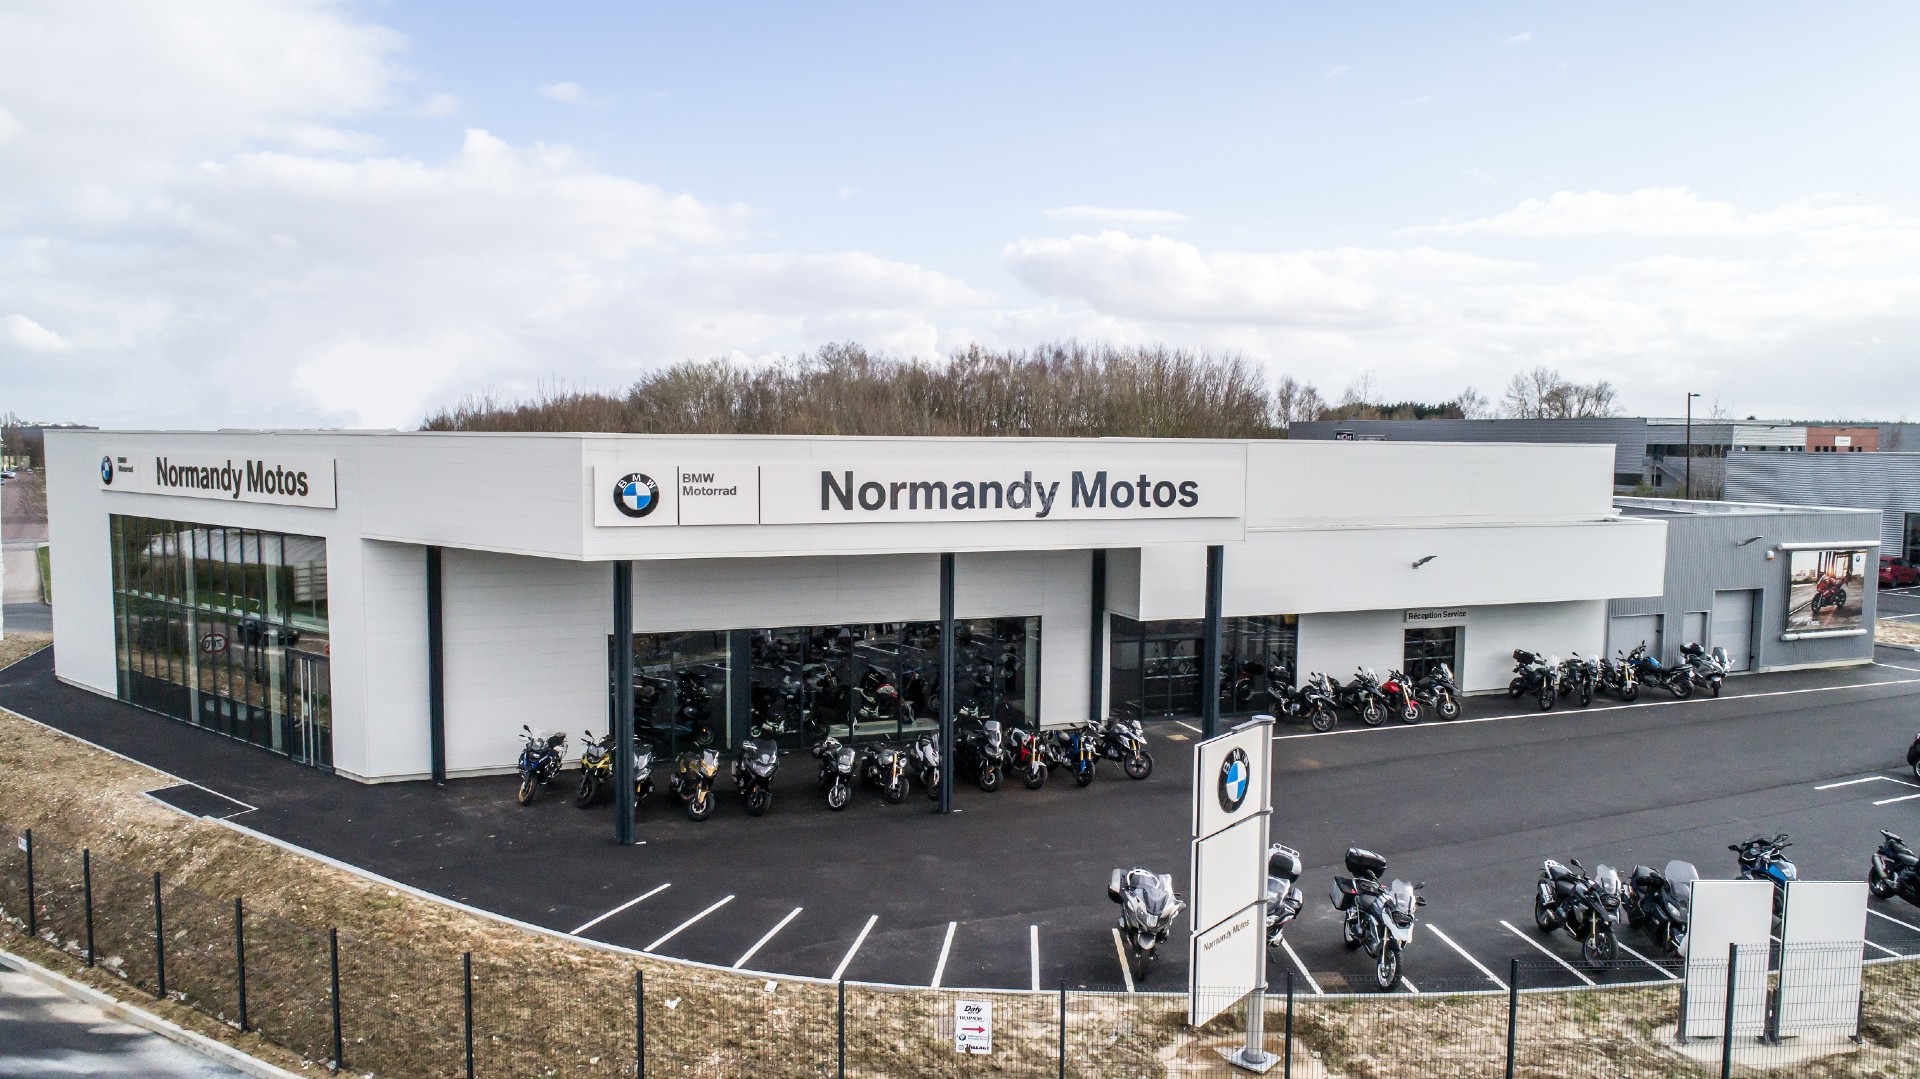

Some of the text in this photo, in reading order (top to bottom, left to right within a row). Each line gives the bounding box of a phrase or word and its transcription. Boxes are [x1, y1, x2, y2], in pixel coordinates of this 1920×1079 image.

[156, 456, 309, 498] Normandy Motos
[682, 473, 714, 483] BMW
[682, 485, 737, 496] Motorrad
[821, 471, 1199, 518] Normandy Motos
[1442, 610, 1467, 618] Service
[1203, 920, 1250, 952] Normandy Motos
